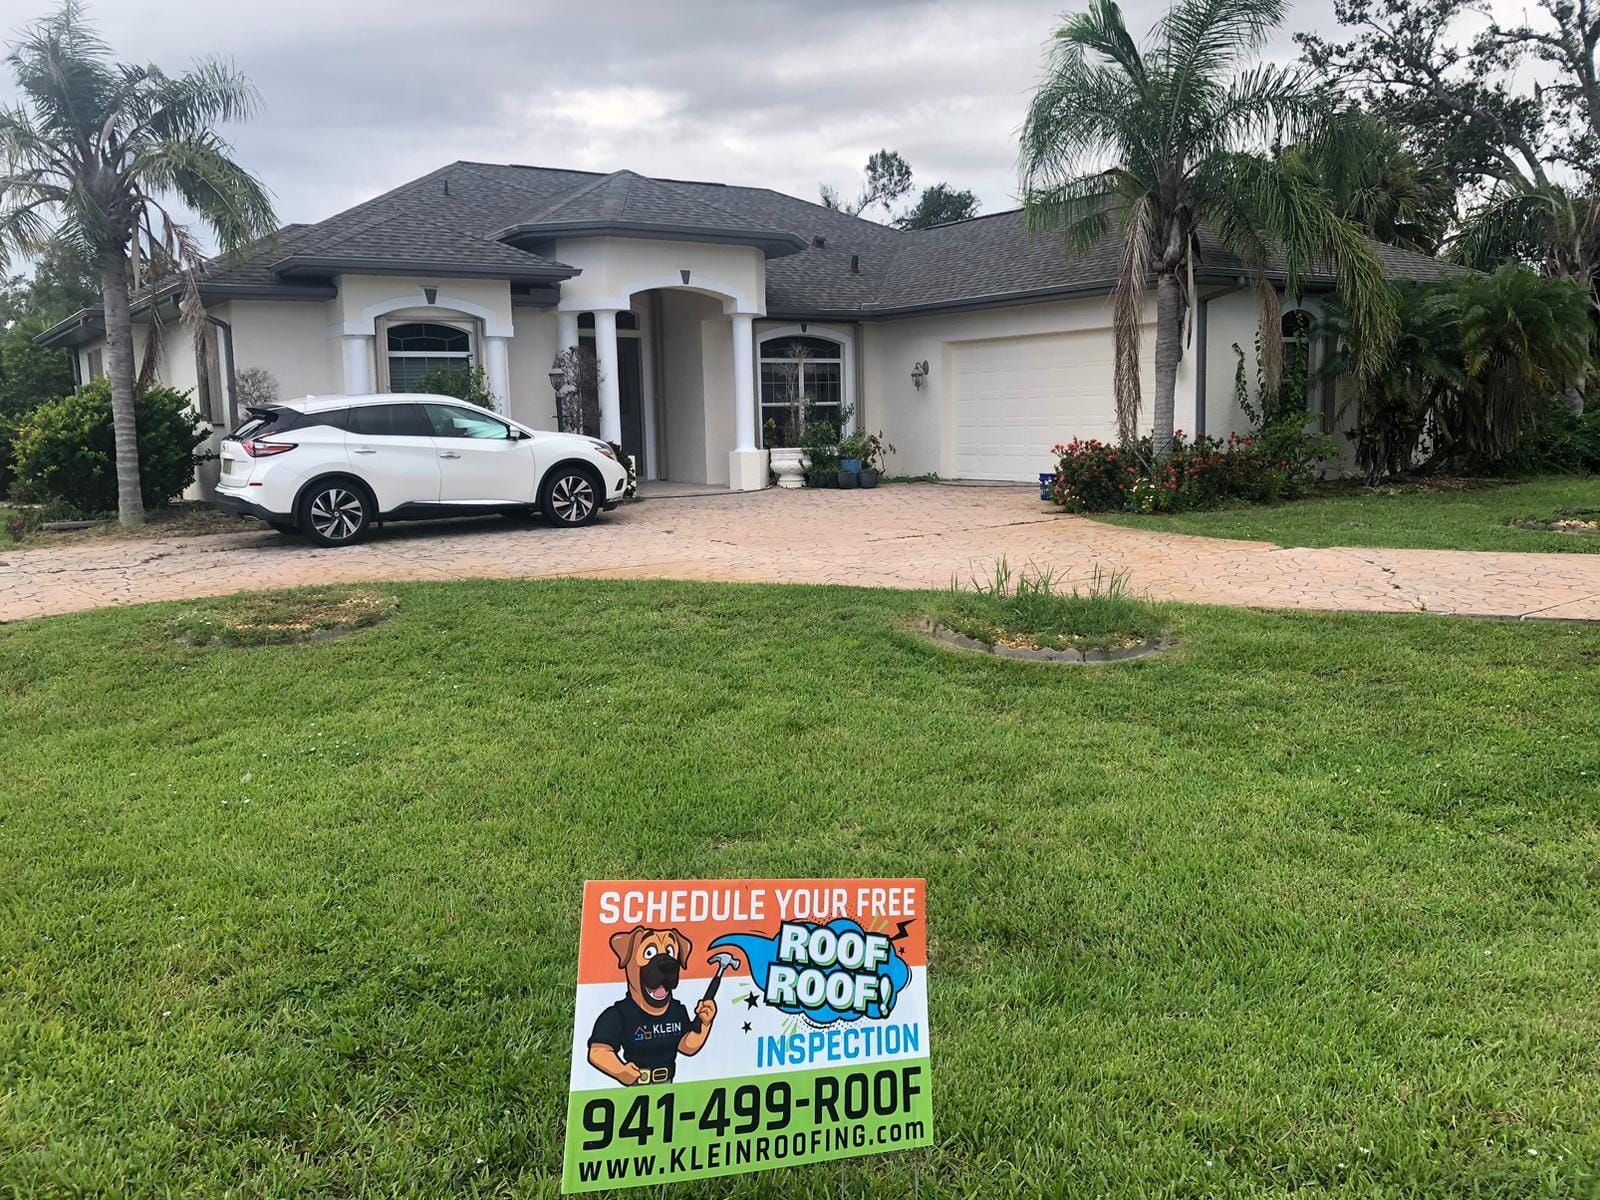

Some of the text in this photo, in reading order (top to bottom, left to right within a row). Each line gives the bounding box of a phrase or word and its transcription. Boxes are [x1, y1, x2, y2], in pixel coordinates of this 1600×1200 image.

[600, 887, 916, 924] SCHEDULE YOUR FREE
[780, 923, 889, 970] ROOF
[766, 963, 894, 1016] ROOF!
[652, 1022, 682, 1034] KLEIN
[757, 1023, 919, 1067] INSPECTION
[583, 1066, 922, 1151] 941-499-ROOF
[578, 1121, 925, 1182] www.KLEINROOFING.com
